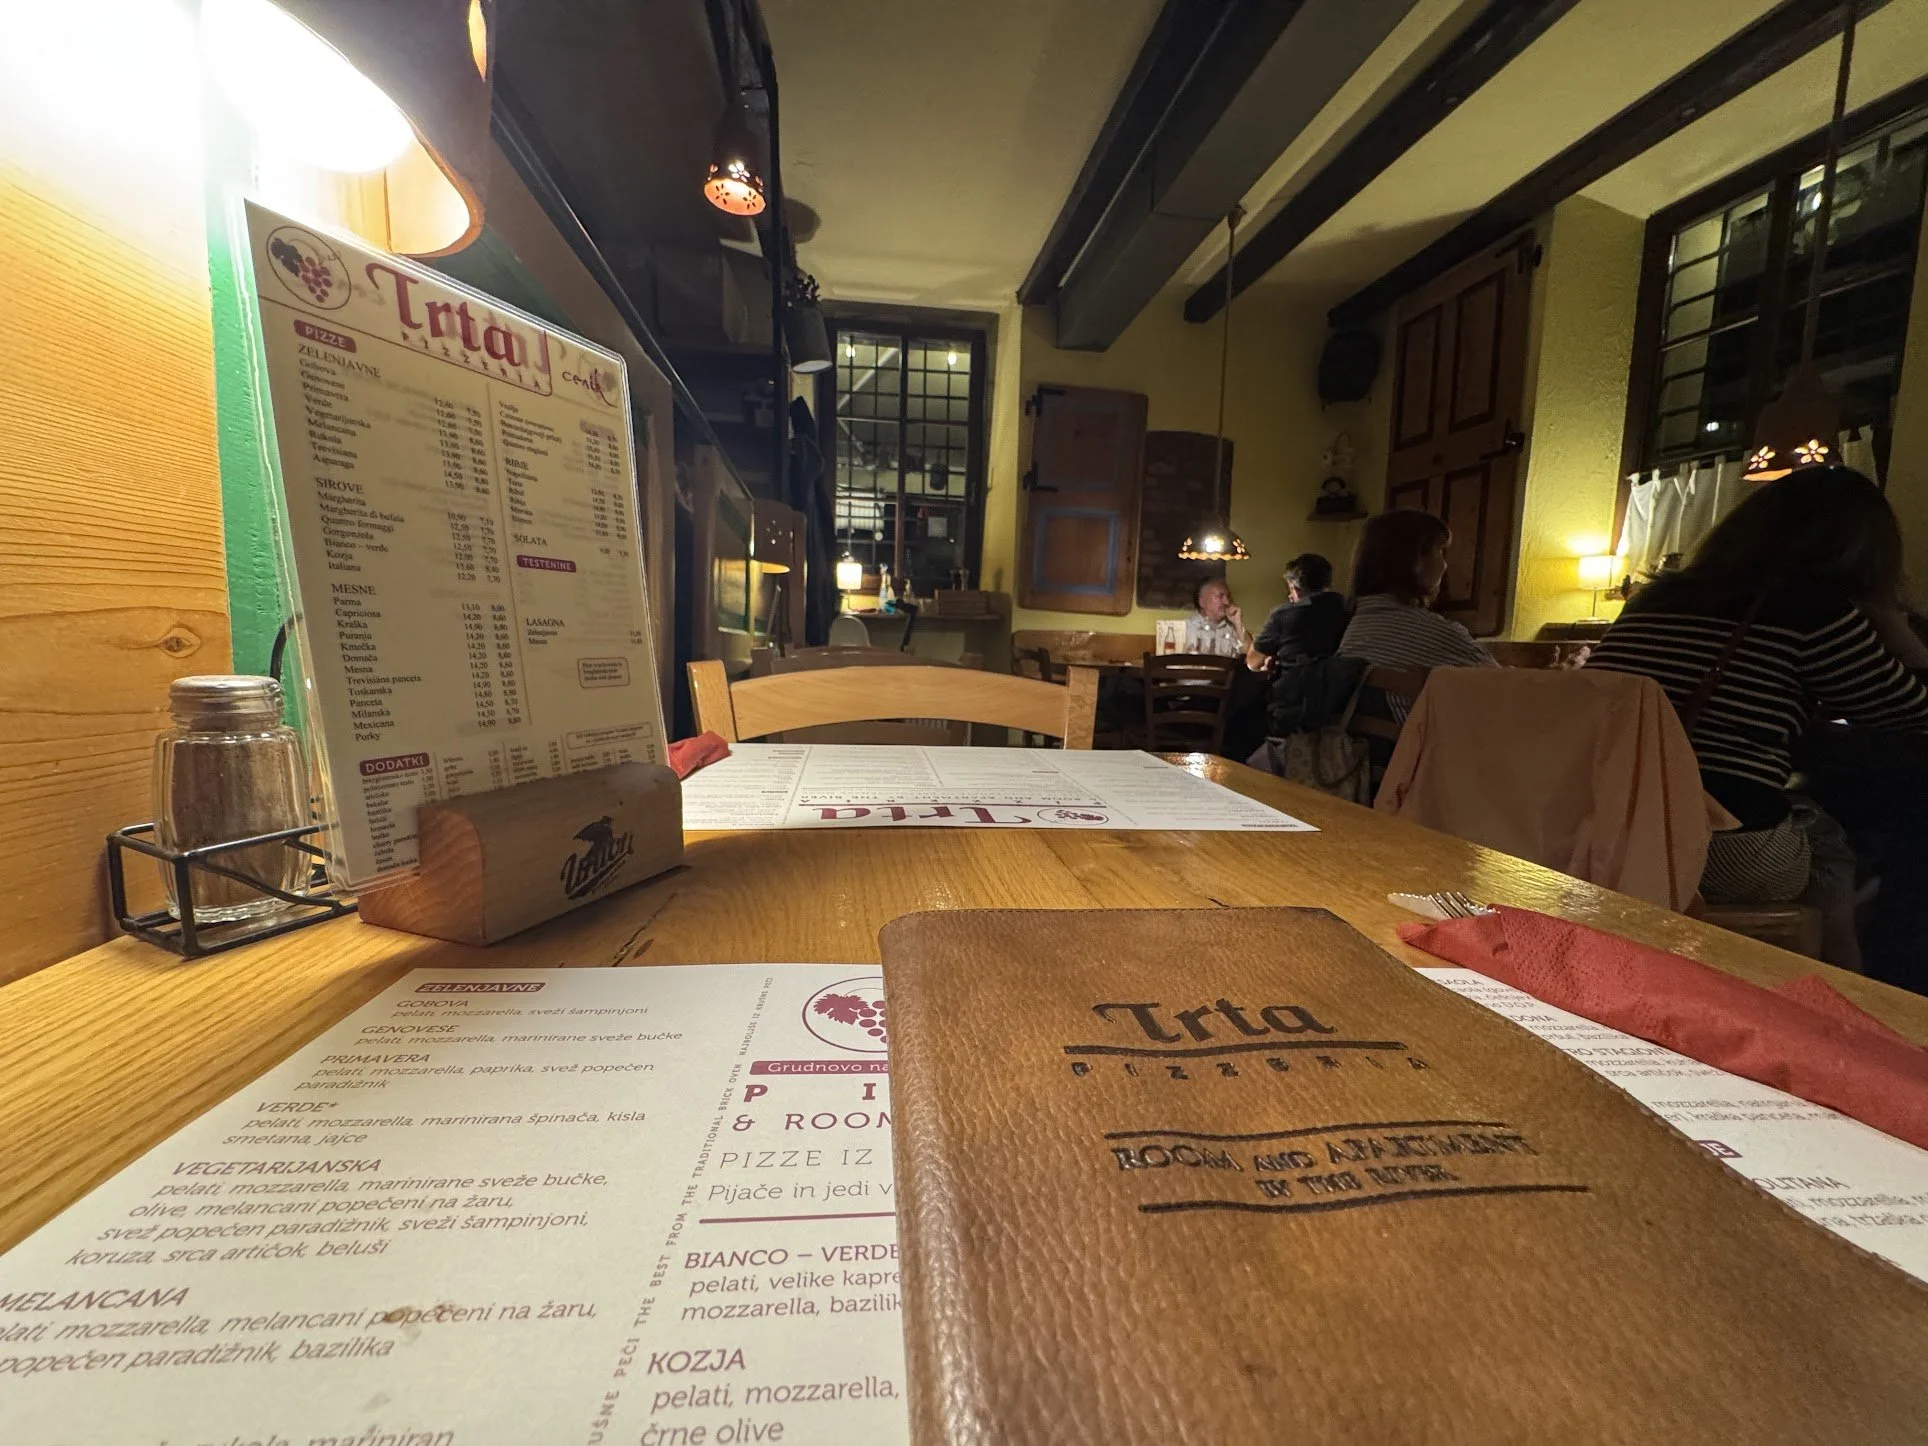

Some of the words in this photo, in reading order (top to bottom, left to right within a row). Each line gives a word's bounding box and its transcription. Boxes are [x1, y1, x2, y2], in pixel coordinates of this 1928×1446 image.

[365, 262, 522, 367] Trta
[305, 326, 347, 348] PIZZE
[298, 343, 381, 378] ZELENJAVNE
[401, 331, 541, 390] PIZZERIA
[302, 381, 349, 401] Primavera
[304, 393, 333, 408] Verde
[315, 476, 364, 494] SIROVE
[322, 526, 374, 541] Gorgonzola
[513, 534, 548, 546] SOLATA
[324, 538, 357, 549] Bianco
[328, 561, 361, 572] Italiana
[522, 557, 573, 571] TESTENINE
[331, 583, 376, 595] MESNE
[335, 609, 381, 619] Capriciosa
[526, 618, 565, 627] LASAGNA
[337, 619, 368, 629] Kraška
[339, 631, 372, 641] Puranja
[340, 642, 377, 651] Kmečka
[342, 653, 378, 662] Domača
[344, 665, 373, 674] Mesna
[391, 675, 421, 685] panceta
[347, 686, 392, 696] Toskanska
[350, 698, 383, 707] Panceta
[352, 709, 391, 719] Milanska
[353, 720, 395, 730] Mexicana
[355, 732, 381, 742] Porky
[365, 756, 424, 773] DODATKI
[812, 806, 1032, 824] Trta
[419, 983, 542, 992] ZELENJAVNE
[396, 1000, 469, 1008] GOBOVA
[528, 1007, 566, 1016] sveži
[568, 1006, 649, 1017] šampinjoni
[361, 1024, 460, 1033] GENOVESE
[1091, 997, 1339, 1045] Trta
[502, 1032, 586, 1042] marinirane
[591, 1032, 633, 1042] sveže
[636, 1031, 683, 1041] bučke
[320, 1054, 431, 1064] PRIMAVERA
[767, 1062, 863, 1073] Grudnovo
[1070, 1055, 1432, 1080] PIZZERIA
[540, 1062, 580, 1073] svež
[580, 1062, 654, 1074] popečen
[295, 1077, 392, 1091] paradižnik
[306, 1115, 414, 1128] mozzarella,
[420, 1113, 523, 1126] marinirana
[526, 1112, 600, 1125] špinača,
[606, 1111, 646, 1122] kisla
[732, 1114, 756, 1131] &
[222, 1133, 310, 1145] smetana,
[313, 1132, 368, 1146] jajce
[720, 1150, 822, 1169] PIZZE
[841, 1149, 873, 1166] IZ
[1111, 1144, 1244, 1172] ROOM
[1253, 1151, 1319, 1172] AND
[1325, 1134, 1539, 1165] APARTMENT
[172, 1159, 382, 1176] VEGETARIJANSKA
[228, 1178, 350, 1195] mozzarella,
[358, 1175, 475, 1191] marinirane
[478, 1174, 538, 1188] sveže
[542, 1172, 609, 1187] bučke,
[1297, 1171, 1363, 1195] THE
[1364, 1164, 1459, 1186] RIVER
[708, 1183, 783, 1205] Pijače
[793, 1182, 815, 1198] in
[822, 1181, 869, 1201] jedi
[129, 1203, 187, 1218] olive,
[194, 1199, 321, 1217] melancani
[317, 1194, 428, 1215] popečeni
[429, 1197, 458, 1209] na
[462, 1194, 513, 1209] žaru,
[97, 1224, 158, 1241] svež
[153, 1221, 264, 1243] popečen
[398, 1214, 459, 1231] sveži
[460, 1211, 589, 1231] šampinjoni,
[613, 1337, 640, 1378] PEČI
[633, 1297, 656, 1328] THE
[649, 1254, 671, 1288] BEST
[665, 1213, 687, 1247] FROM
[681, 1183, 698, 1206] THE
[692, 1115, 724, 1178] TRADITIONAL
[718, 1087, 733, 1111] BRICK
[728, 1064, 742, 1084] OVEN
[65, 1249, 154, 1265] koruza,
[163, 1247, 218, 1263] srca
[219, 1241, 308, 1262] artičok,
[315, 1239, 392, 1257] beluši
[684, 1248, 789, 1269] BIANCO
[821, 1243, 900, 1262] VERDE
[689, 1275, 760, 1298] pelati,
[769, 1271, 835, 1290] velike
[0, 1287, 190, 1312] MELANCANA
[681, 1297, 820, 1321] mozzarella,
[54, 1314, 209, 1342] mozzarella,
[219, 1307, 368, 1333] melancani
[365, 1300, 496, 1330] popečeni
[498, 1305, 532, 1321] na
[537, 1300, 598, 1321] žaru,
[289, 1337, 395, 1361] bazilika
[647, 1348, 746, 1376] KOZJA
[651, 1383, 734, 1414] pelati,
[745, 1376, 899, 1405] mozzarella,
[640, 1421, 714, 1446] črne
[716, 1418, 785, 1444] olive
